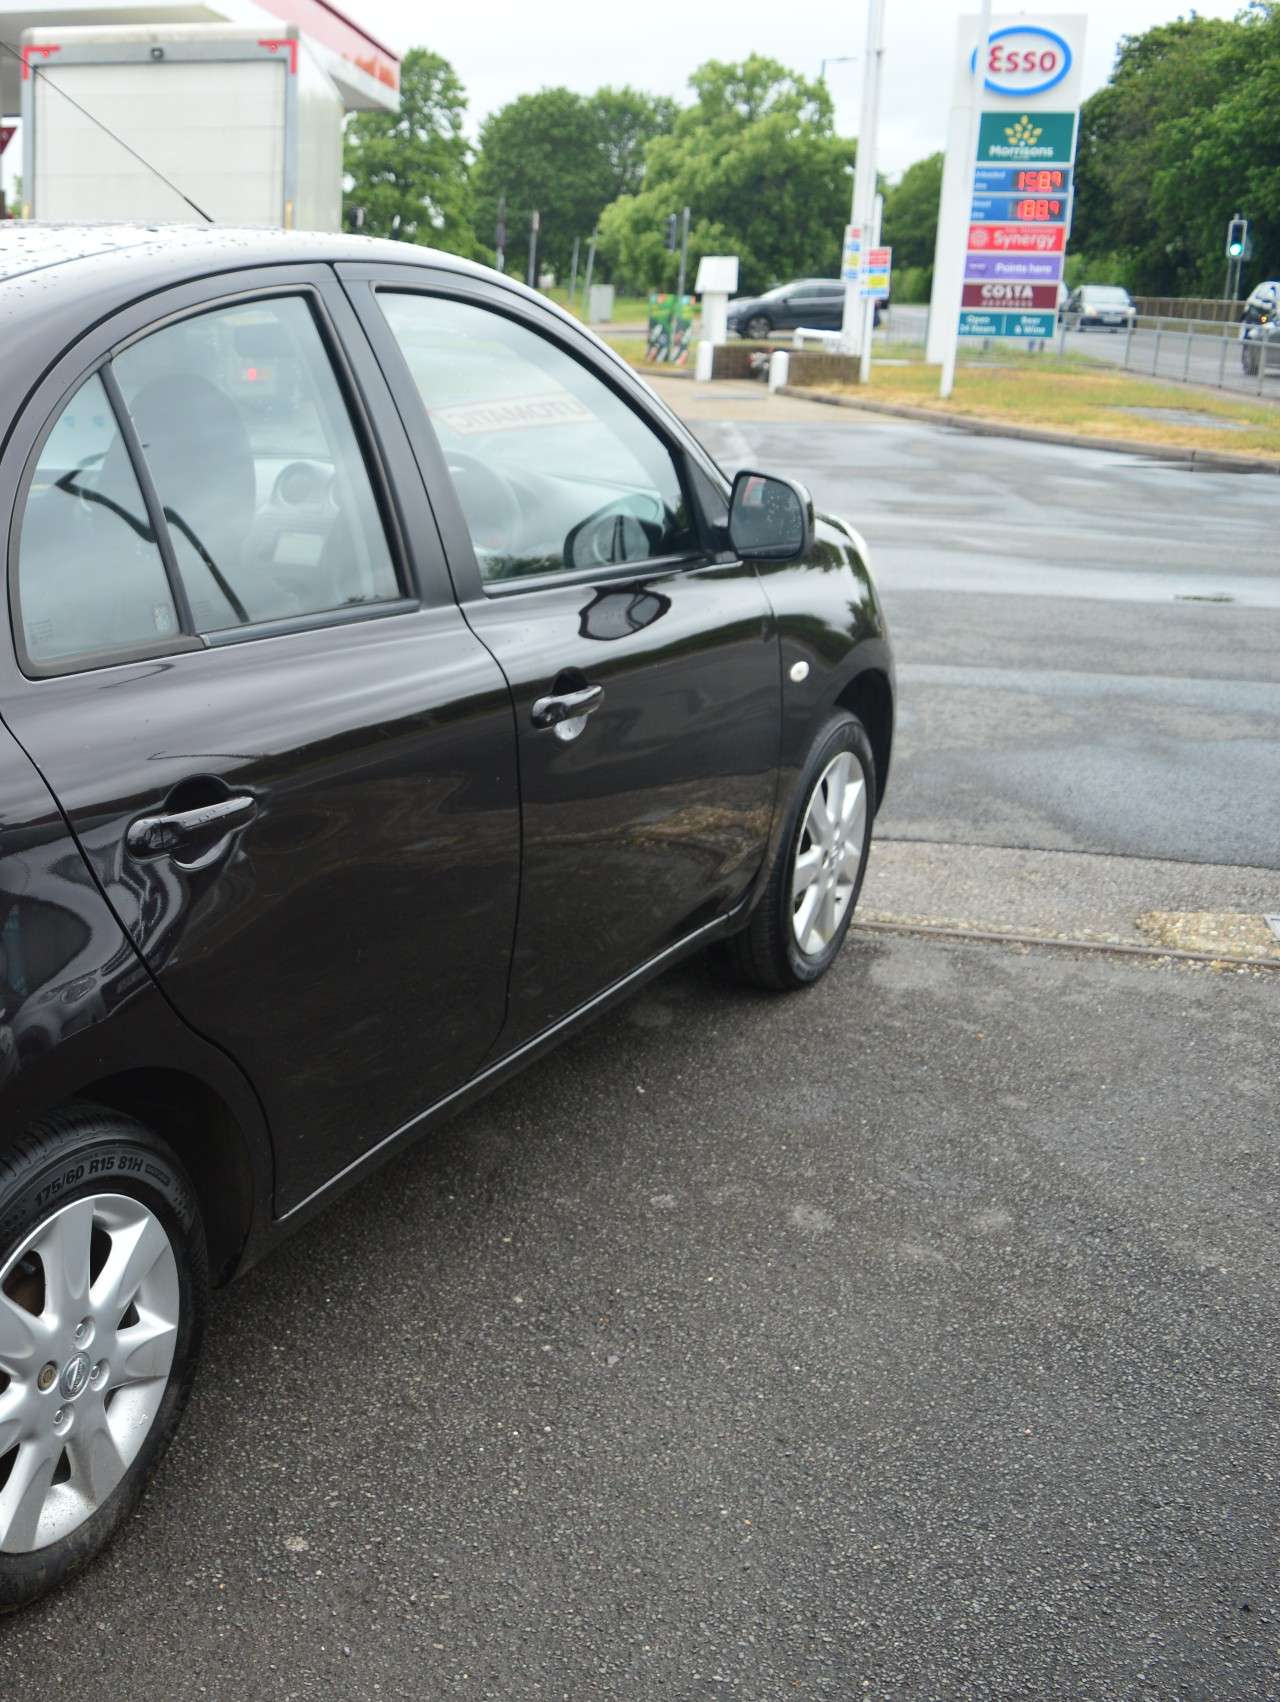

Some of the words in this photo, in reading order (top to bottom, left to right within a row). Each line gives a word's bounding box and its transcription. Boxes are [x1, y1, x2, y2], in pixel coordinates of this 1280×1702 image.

[988, 44, 1057, 73] Esso
[993, 230, 1057, 249] Synergy
[981, 284, 1034, 299] COSTA
[35, 1164, 85, 1207] 175/60
[89, 1157, 115, 1175] R15
[117, 1155, 144, 1173] 81H
